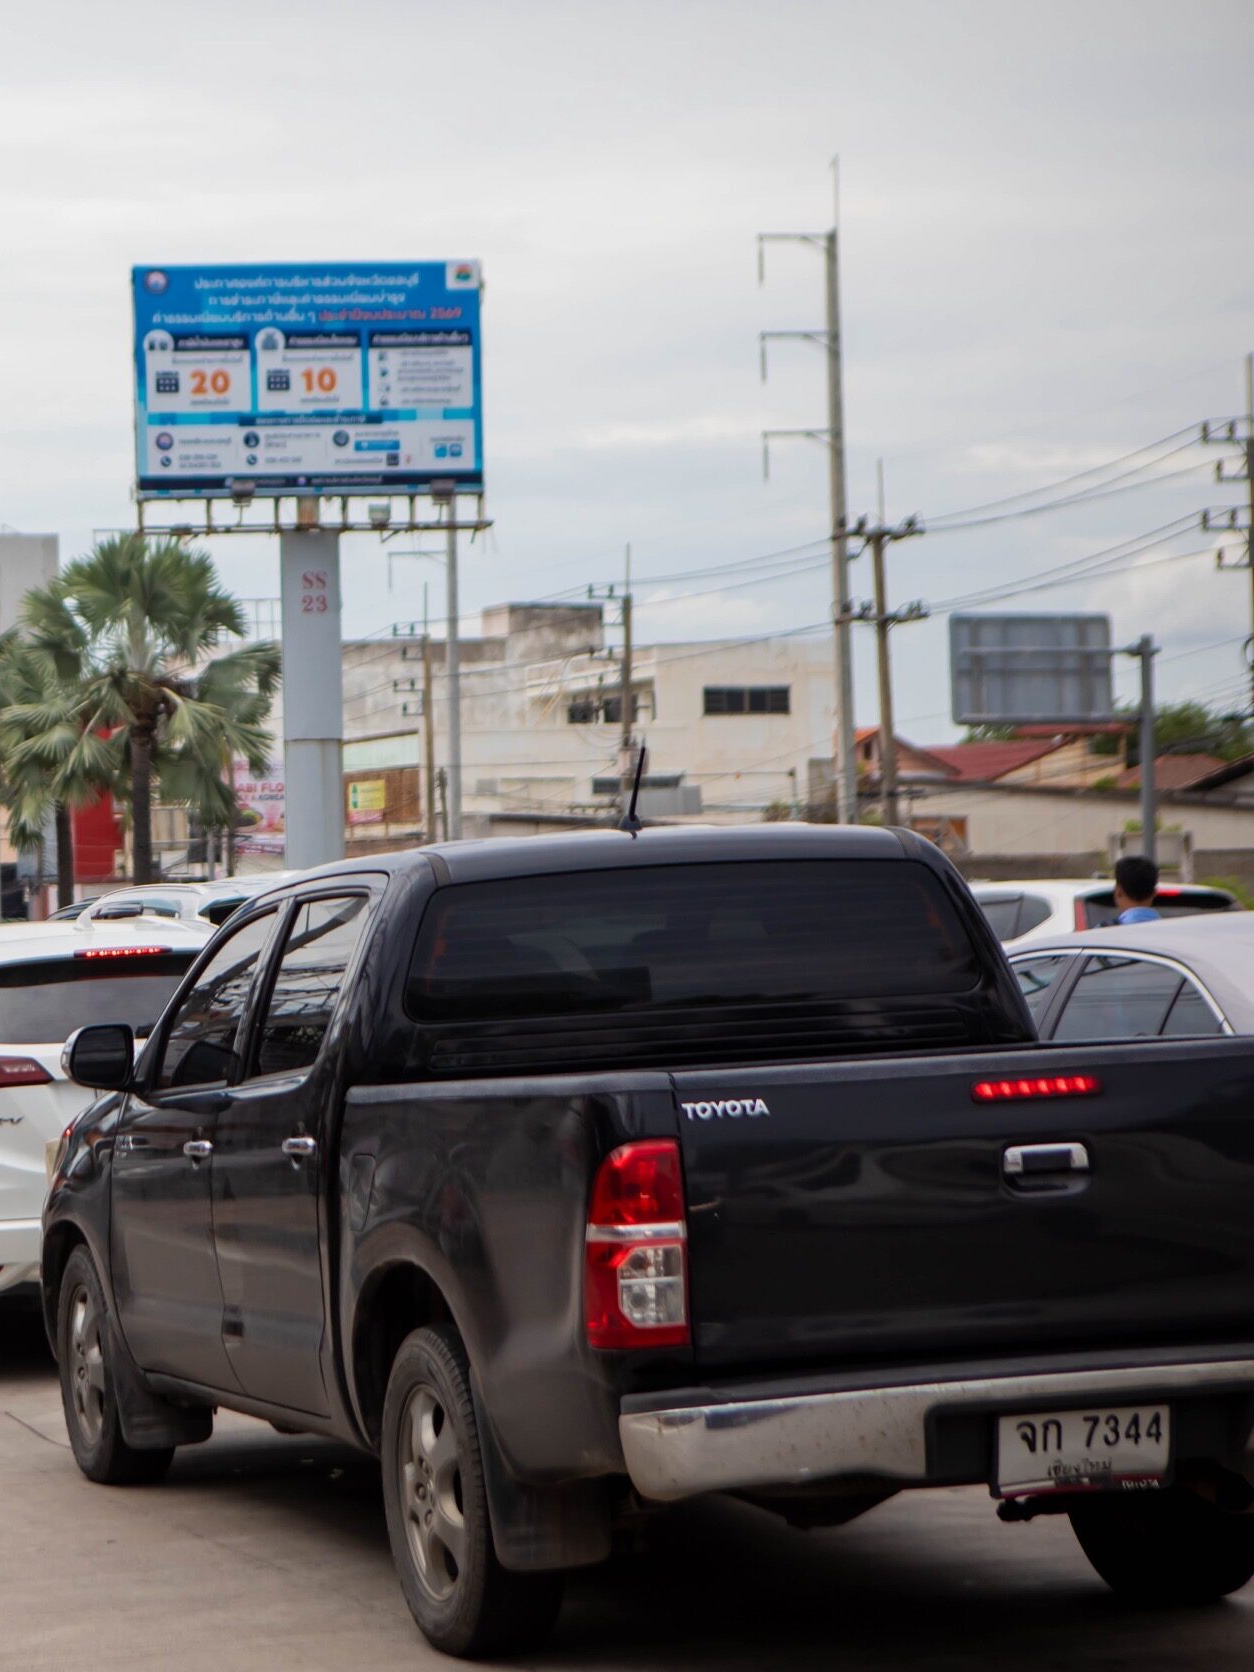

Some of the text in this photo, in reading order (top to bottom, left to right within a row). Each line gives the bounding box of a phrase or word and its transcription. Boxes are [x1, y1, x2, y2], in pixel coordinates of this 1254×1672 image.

[190, 368, 232, 395] 20
[300, 367, 337, 393] 10
[302, 570, 327, 590] SS
[301, 594, 328, 614] 23
[681, 1097, 771, 1121] TOYOTA
[1016, 1410, 1162, 1454] จก 7344
